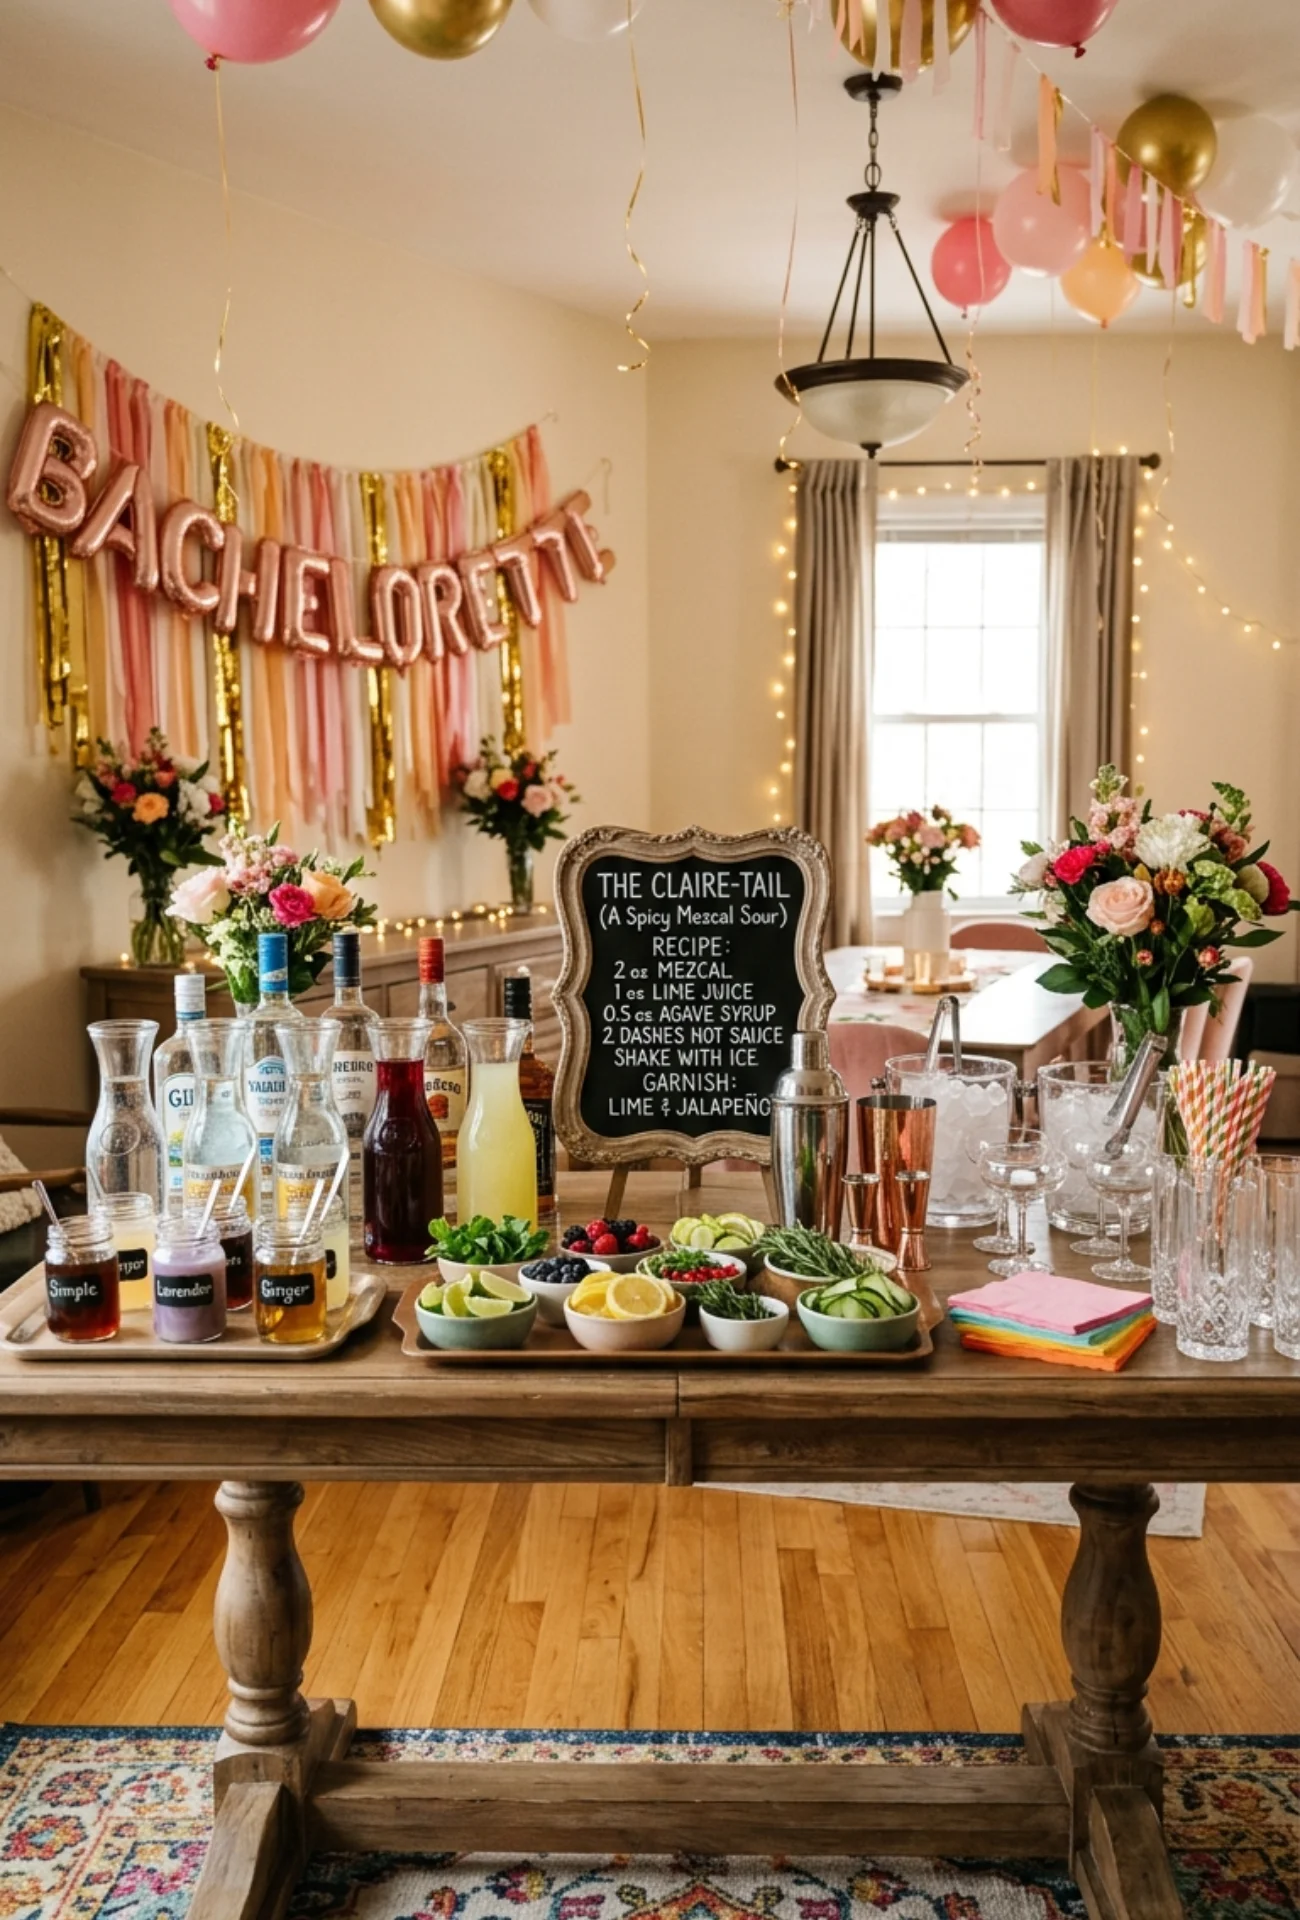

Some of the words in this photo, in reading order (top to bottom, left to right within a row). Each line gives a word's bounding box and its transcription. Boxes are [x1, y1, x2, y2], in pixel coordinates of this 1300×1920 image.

[597, 872, 643, 898] THE
[651, 872, 791, 898] CLAIRE-TAIL
[599, 903, 621, 930] (A
[626, 906, 671, 932] Spicy
[677, 905, 734, 925] Mezcal
[740, 902, 788, 929] Sour)
[652, 937, 731, 956] RECIPE:
[613, 961, 626, 979] 2
[658, 961, 733, 979] MEZCAL
[615, 983, 622, 1000] 1
[652, 983, 695, 1000] LIME
[701, 983, 754, 1000] JUICE
[603, 1005, 631, 1022] 0.5
[659, 1005, 715, 1022] AGAVE
[720, 1004, 777, 1022] SYRUP
[602, 1026, 615, 1044] 2
[729, 1026, 784, 1044] SAUCE
[614, 1048, 671, 1067] SHAKE
[676, 1048, 722, 1067] WITH
[730, 1048, 759, 1067] ICE
[642, 1073, 737, 1092] GARNISH:
[608, 1097, 654, 1116] LIME
[261, 1279, 310, 1304] Ginger
